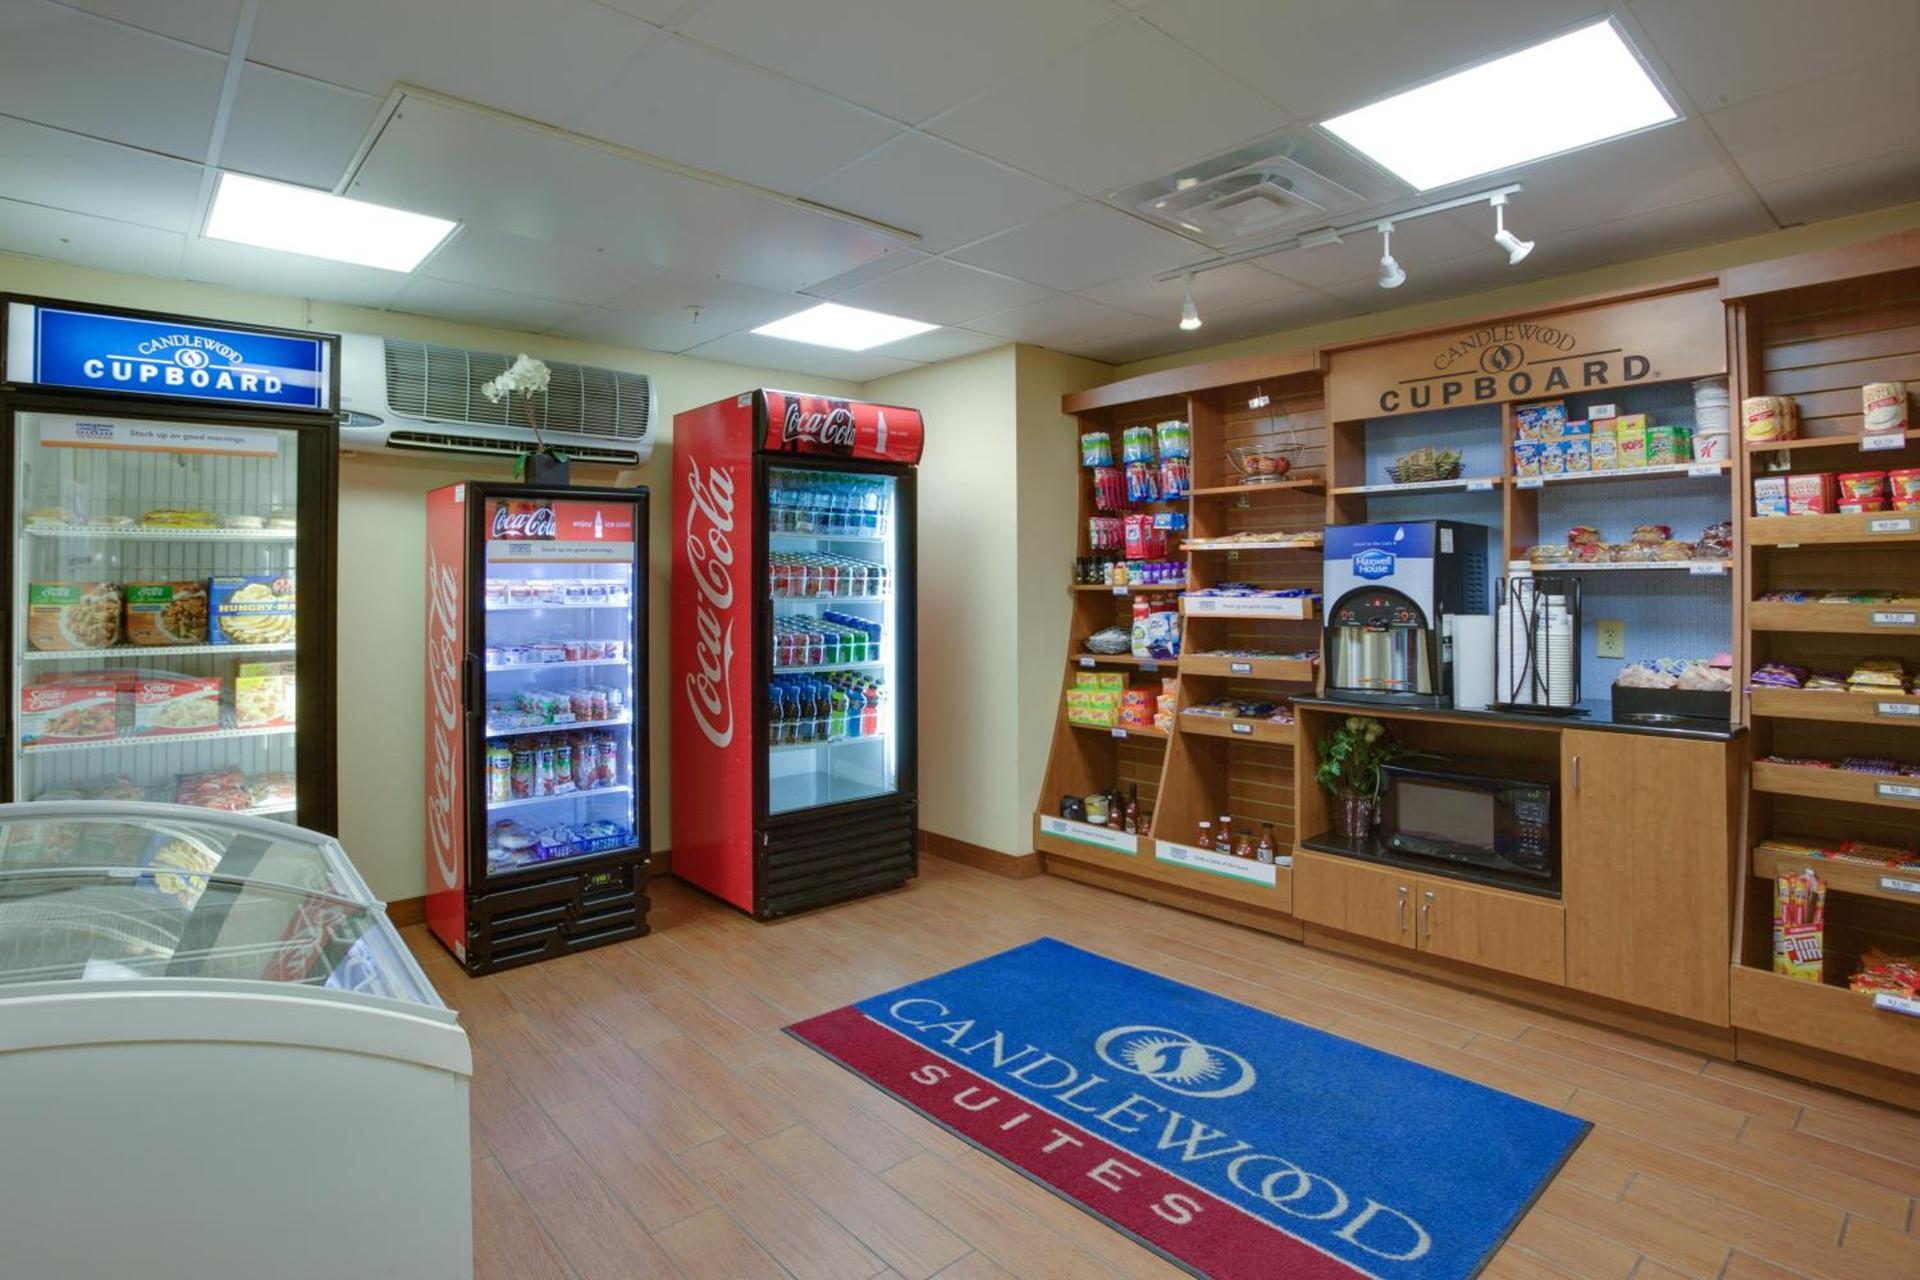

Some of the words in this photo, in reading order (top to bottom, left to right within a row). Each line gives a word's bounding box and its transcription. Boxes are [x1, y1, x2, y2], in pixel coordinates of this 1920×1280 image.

[138, 335, 243, 364] CANDLEWOOD
[1434, 322, 1576, 371] CANDLEWOOD
[84, 359, 281, 394] CUPBOARD
[1379, 354, 1651, 413] CUPBOARD
[1356, 556, 1392, 567] Maxwell
[219, 602, 296, 613] HUNGRY-MA
[30, 690, 66, 702] Smart
[143, 683, 175, 695] Smart
[889, 997, 1432, 1262] CANDLEWOOD
[910, 1063, 1203, 1227] SUITES
